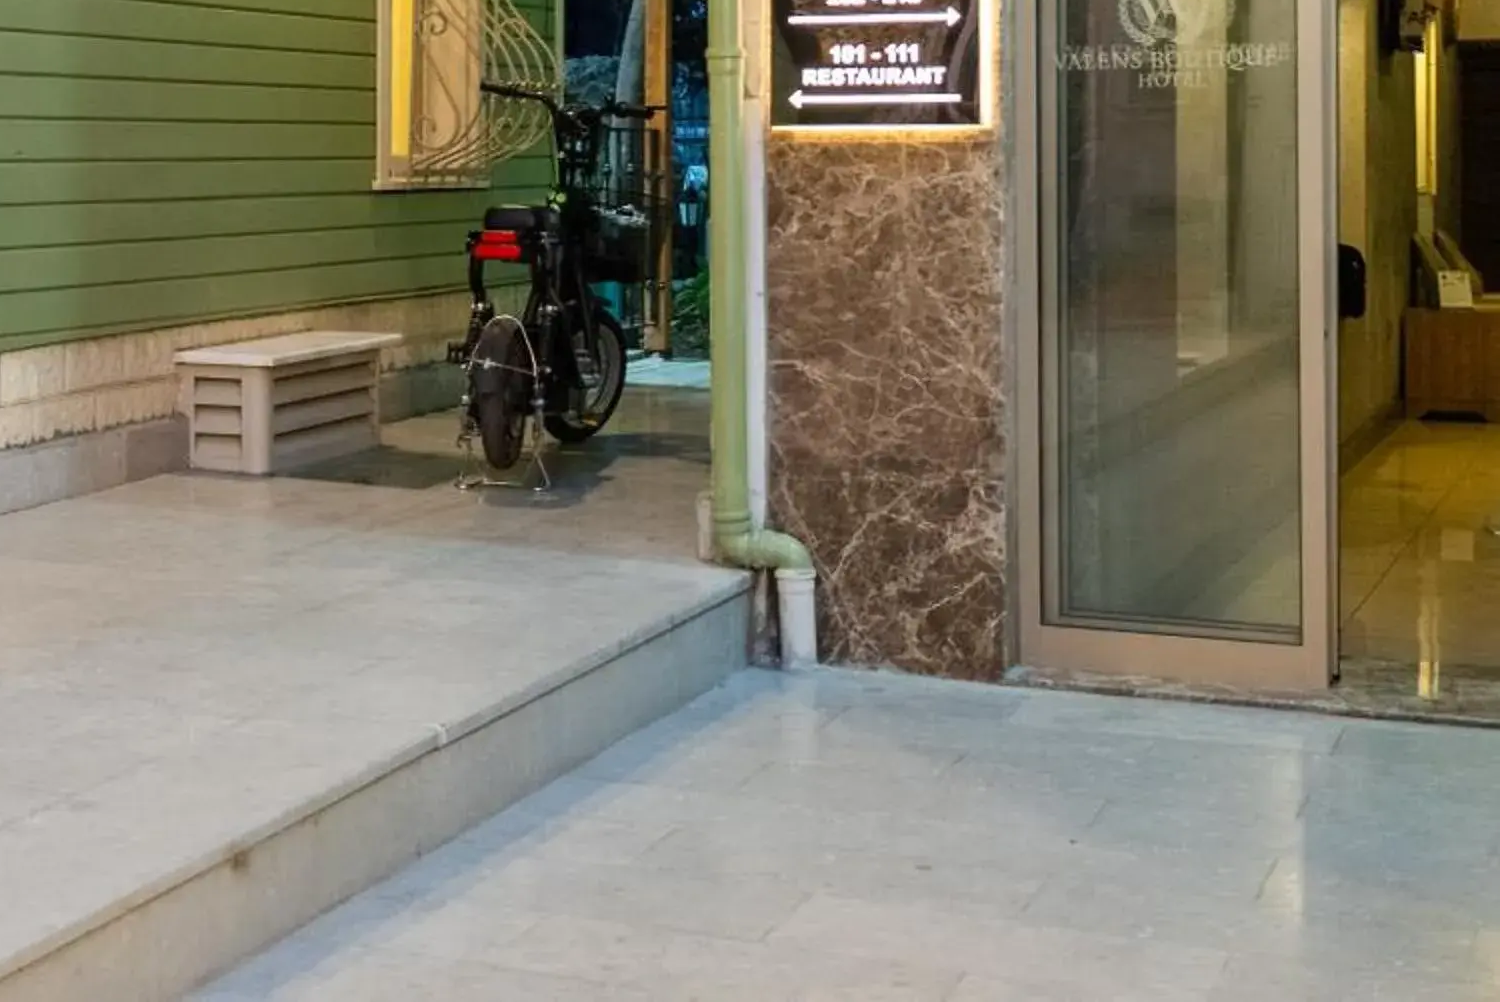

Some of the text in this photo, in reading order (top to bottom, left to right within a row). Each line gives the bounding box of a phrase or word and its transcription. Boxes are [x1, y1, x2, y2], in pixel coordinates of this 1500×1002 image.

[829, 45, 866, 64] 101
[884, 44, 919, 63] 111
[802, 67, 946, 86] RESTAURANT
